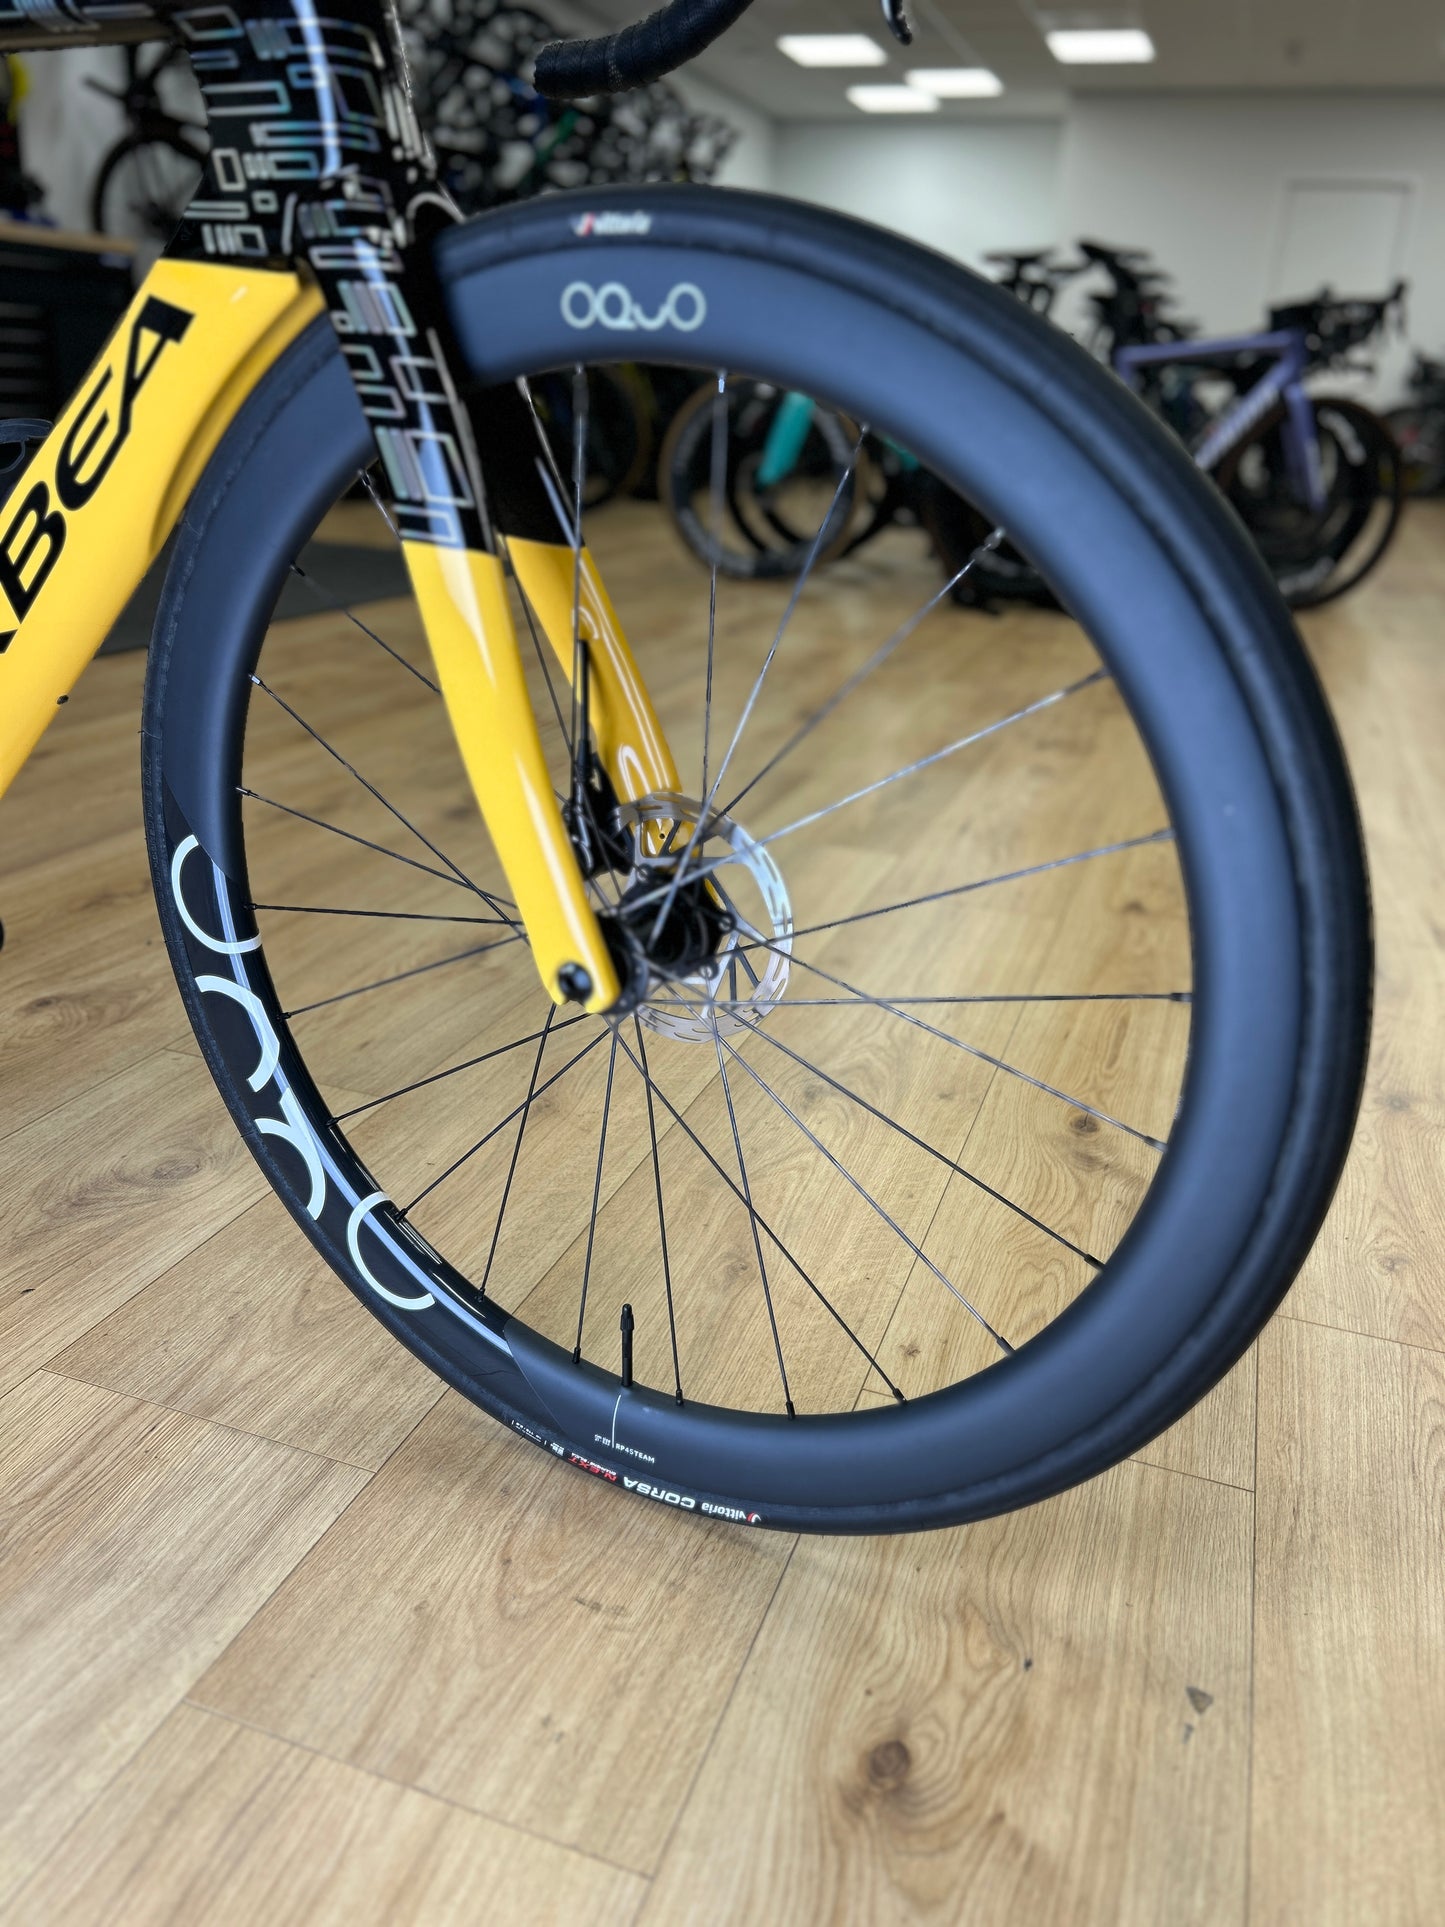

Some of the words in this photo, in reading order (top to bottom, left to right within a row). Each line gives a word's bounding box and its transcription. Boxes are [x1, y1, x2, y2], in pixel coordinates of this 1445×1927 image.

[0, 294, 195, 656] BEA
[623, 1476, 696, 1509] CORSA
[701, 1501, 746, 1520] vittoria
